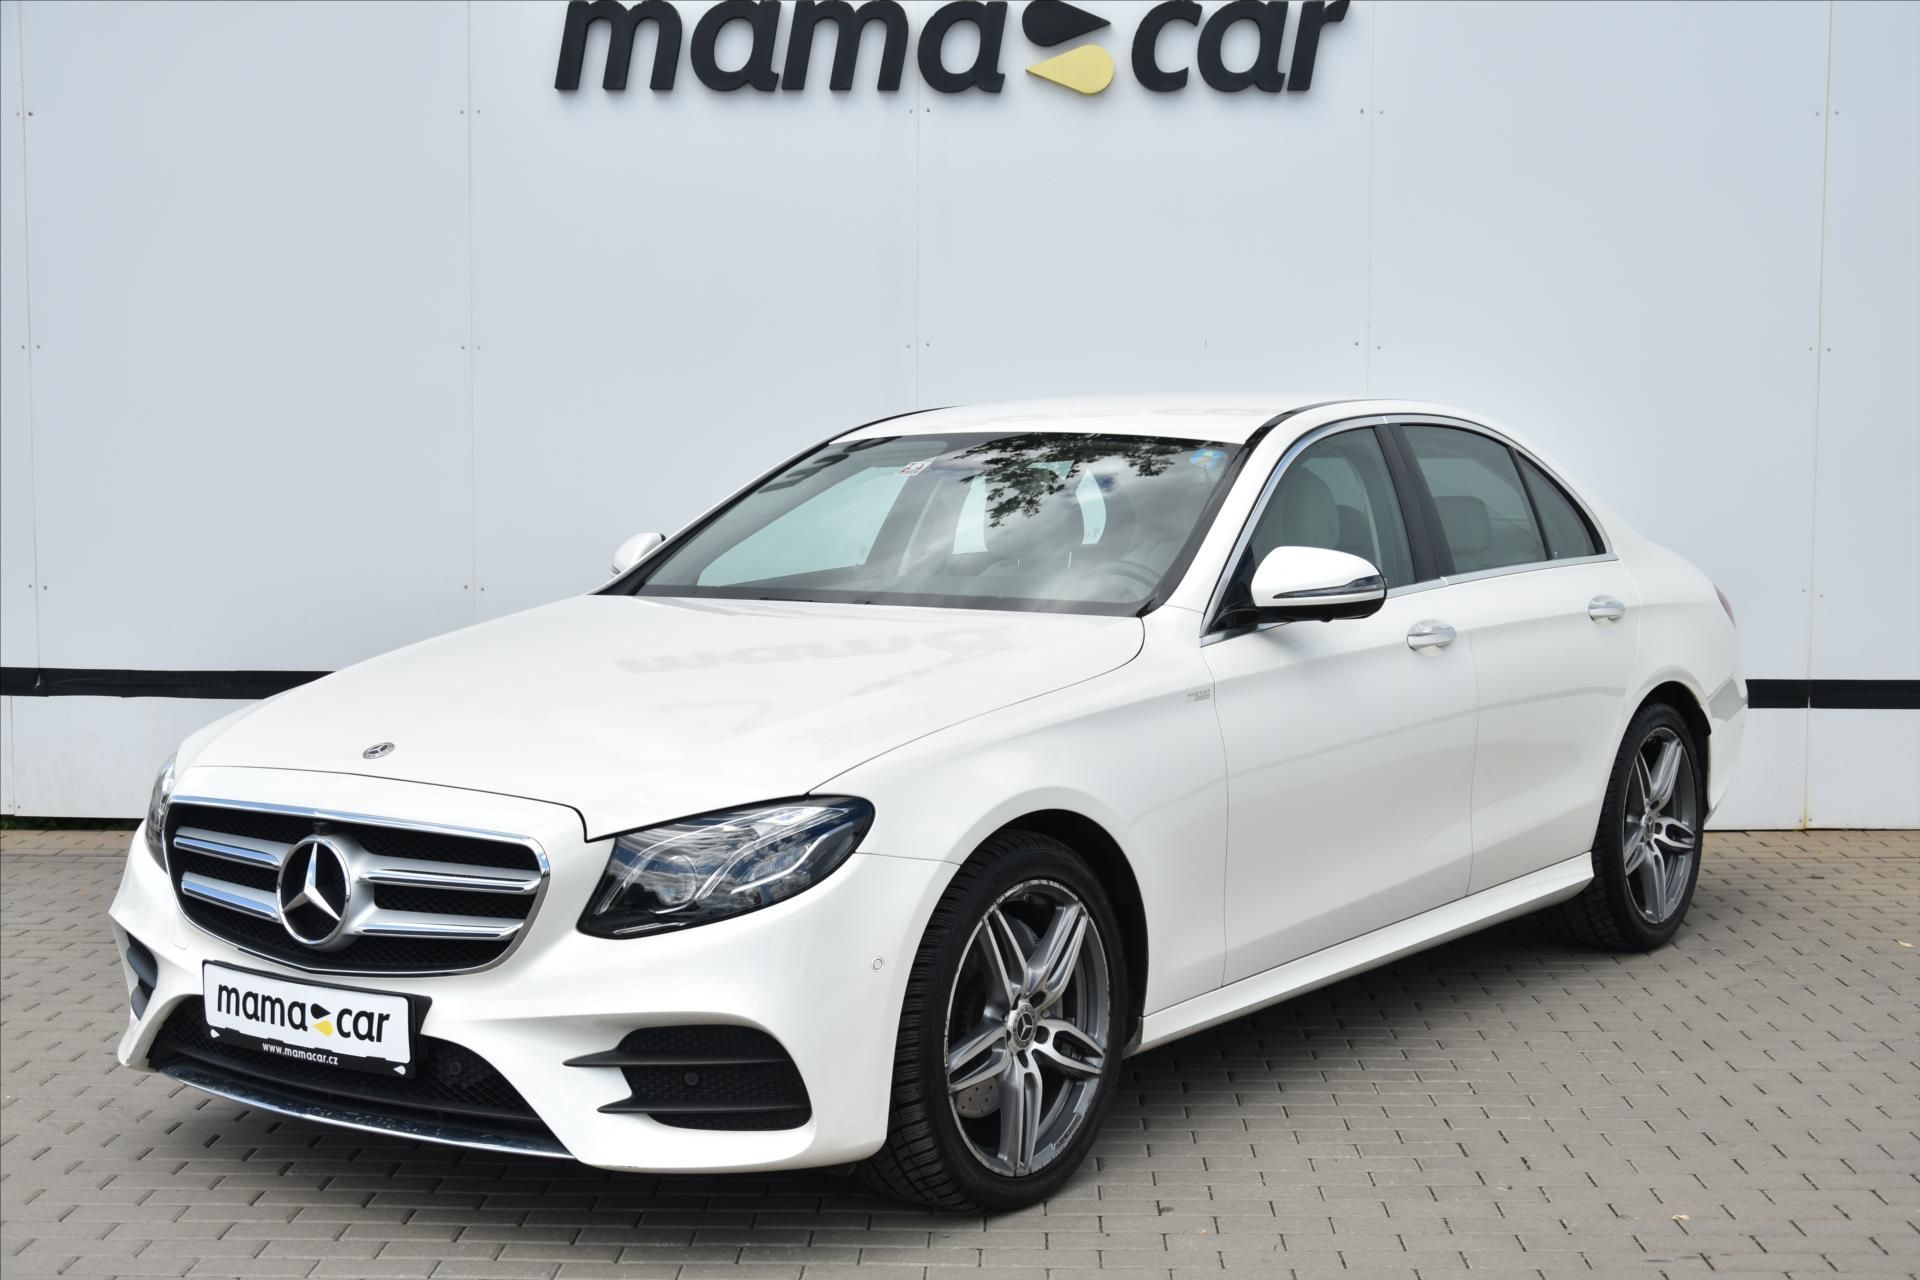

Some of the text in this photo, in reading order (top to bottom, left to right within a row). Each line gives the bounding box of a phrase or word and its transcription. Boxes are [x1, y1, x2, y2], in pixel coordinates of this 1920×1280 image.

[555, 0, 1350, 94] mama car
[217, 984, 391, 1043] mama car
[262, 1042, 339, 1065] www.mamacar.cz
